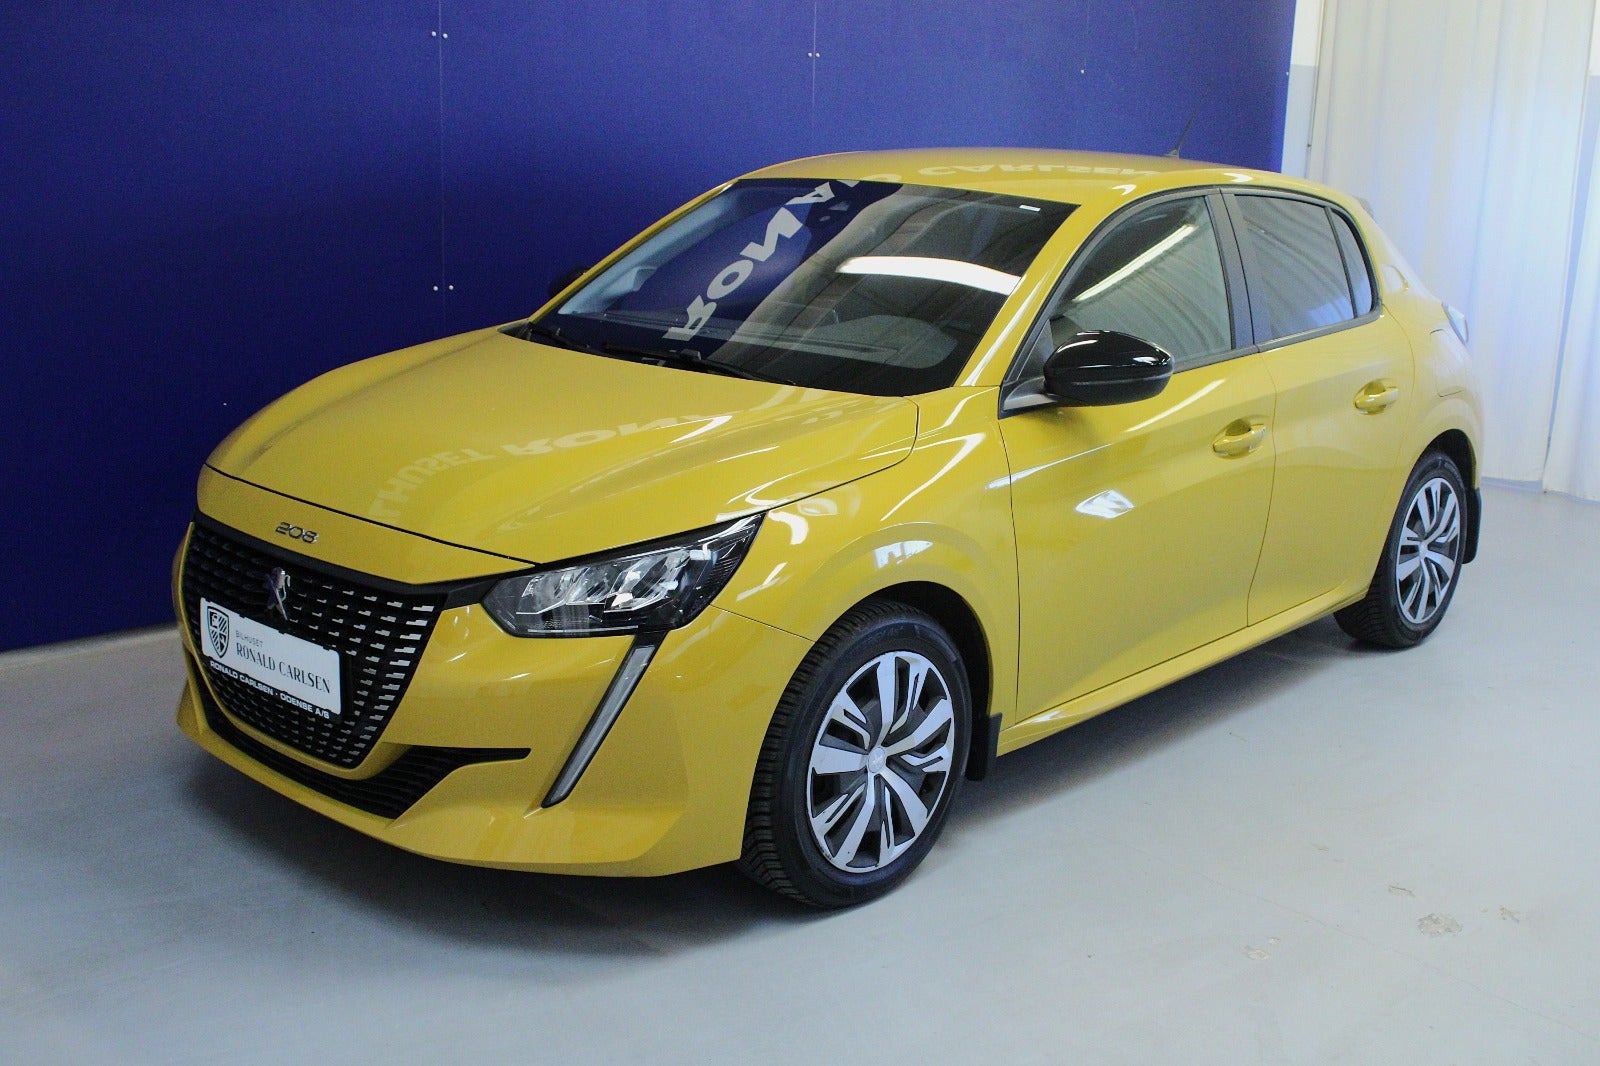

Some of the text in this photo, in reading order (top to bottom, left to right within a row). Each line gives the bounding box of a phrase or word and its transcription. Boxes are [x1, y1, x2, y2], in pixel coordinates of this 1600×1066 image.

[275, 521, 319, 544] 208
[210, 660, 330, 719] RONALD CARLSEN ODENSE A/S
[235, 642, 331, 694] RONALD CARLSEN
